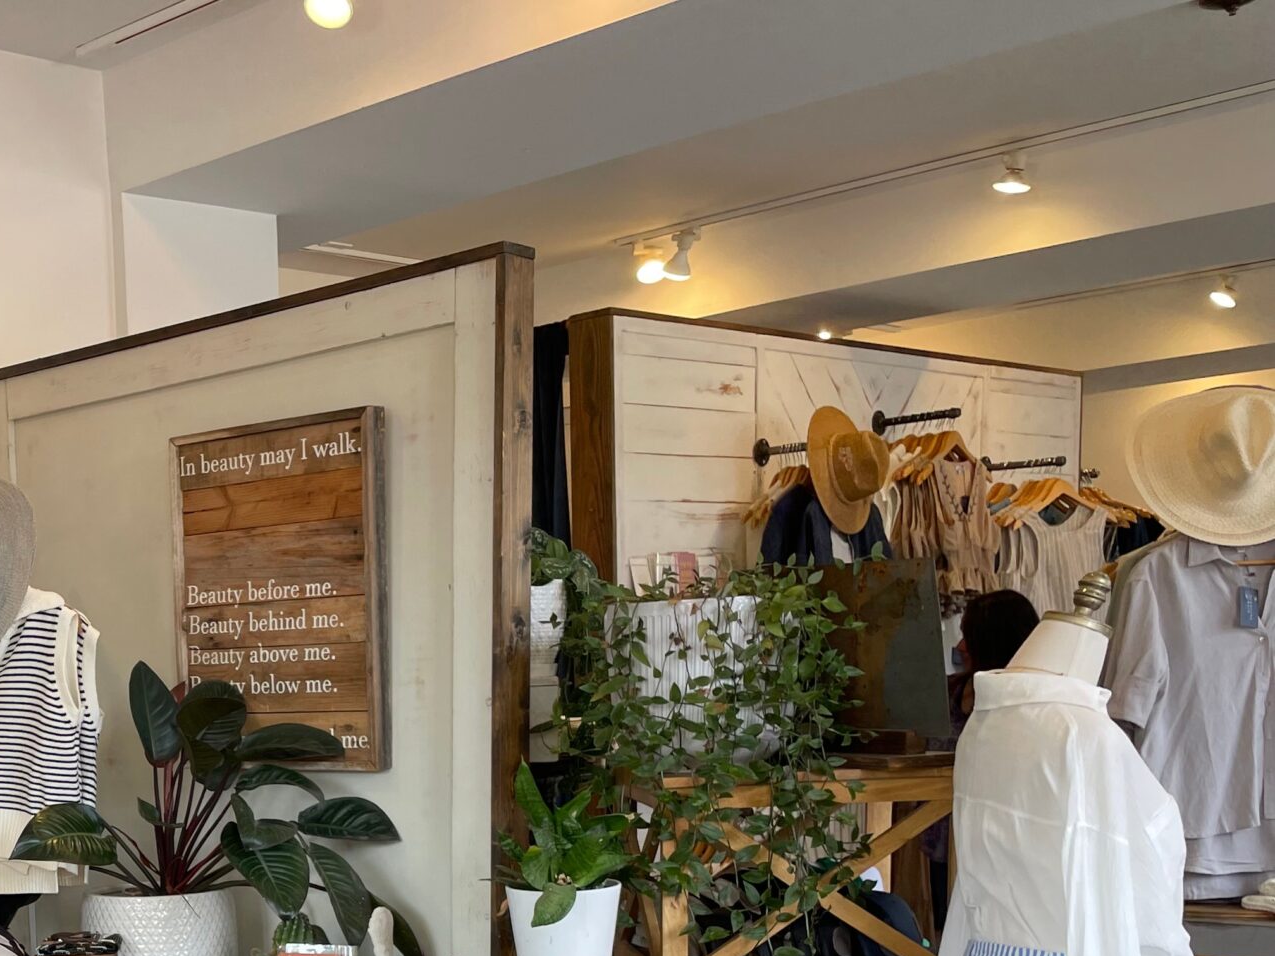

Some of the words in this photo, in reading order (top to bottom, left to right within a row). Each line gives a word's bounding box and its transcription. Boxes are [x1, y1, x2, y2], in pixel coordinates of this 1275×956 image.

[180, 456, 195, 477] In
[201, 453, 255, 475] beauty
[260, 447, 296, 470] may
[300, 438, 308, 460] I
[312, 432, 362, 458] walk.
[186, 585, 243, 608] Beauty
[247, 579, 300, 601] before
[305, 581, 337, 597] me.
[189, 615, 244, 640] Beauty
[249, 609, 307, 632] behind
[312, 613, 345, 629] me.
[189, 645, 245, 671] Beauty
[249, 643, 298, 664] above
[303, 646, 336, 661] me.
[190, 676, 246, 695] Bty
[249, 674, 301, 694] below
[305, 678, 338, 693] me.
